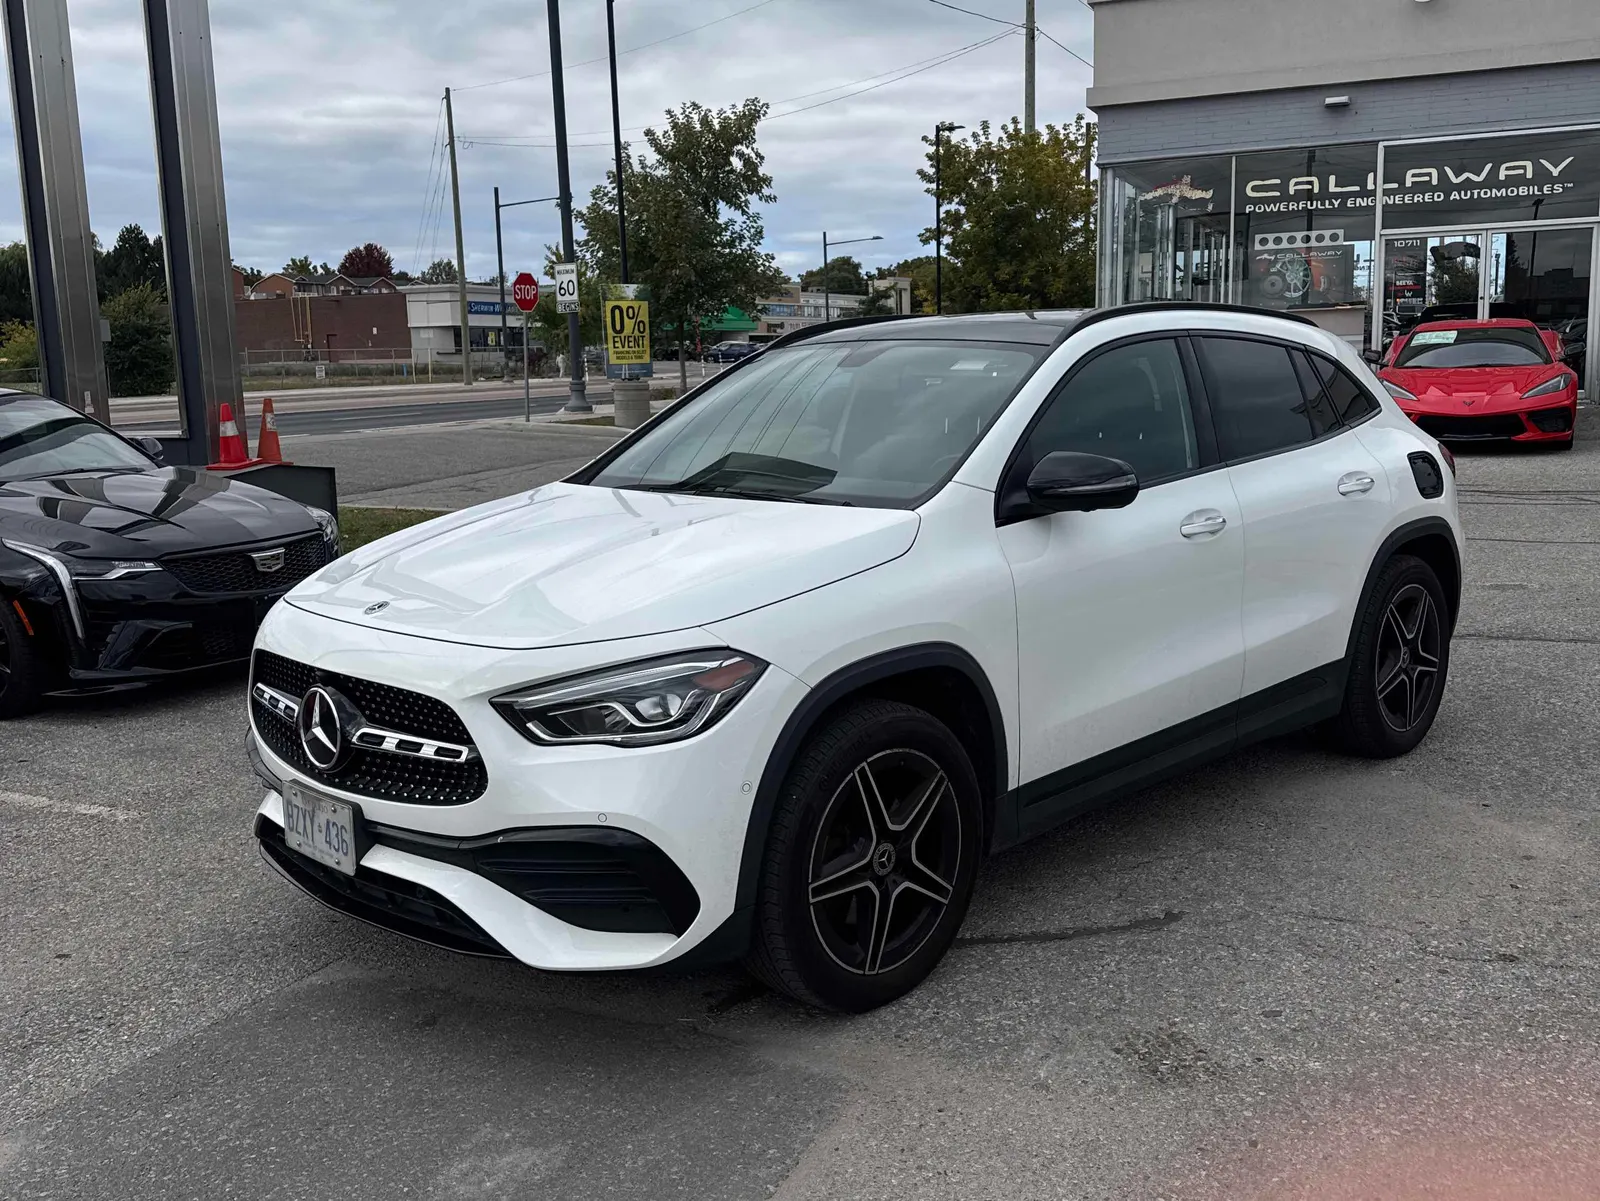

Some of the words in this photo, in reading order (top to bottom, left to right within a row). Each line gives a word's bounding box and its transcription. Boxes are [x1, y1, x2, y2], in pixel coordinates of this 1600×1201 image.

[1245, 156, 1574, 198] CALLAWAY
[1245, 198, 1342, 214] POWERFULLY
[1346, 192, 1444, 208] ENGNEERED
[1393, 240, 1420, 248] 10711
[1276, 250, 1343, 259] CALLAWAY
[515, 285, 537, 299] STOP
[558, 280, 576, 296] 60
[558, 302, 579, 312] BEGINS
[610, 305, 646, 335] 0%
[612, 335, 646, 349] EVENT
[286, 801, 316, 846] BZXY
[325, 818, 349, 857] 436
